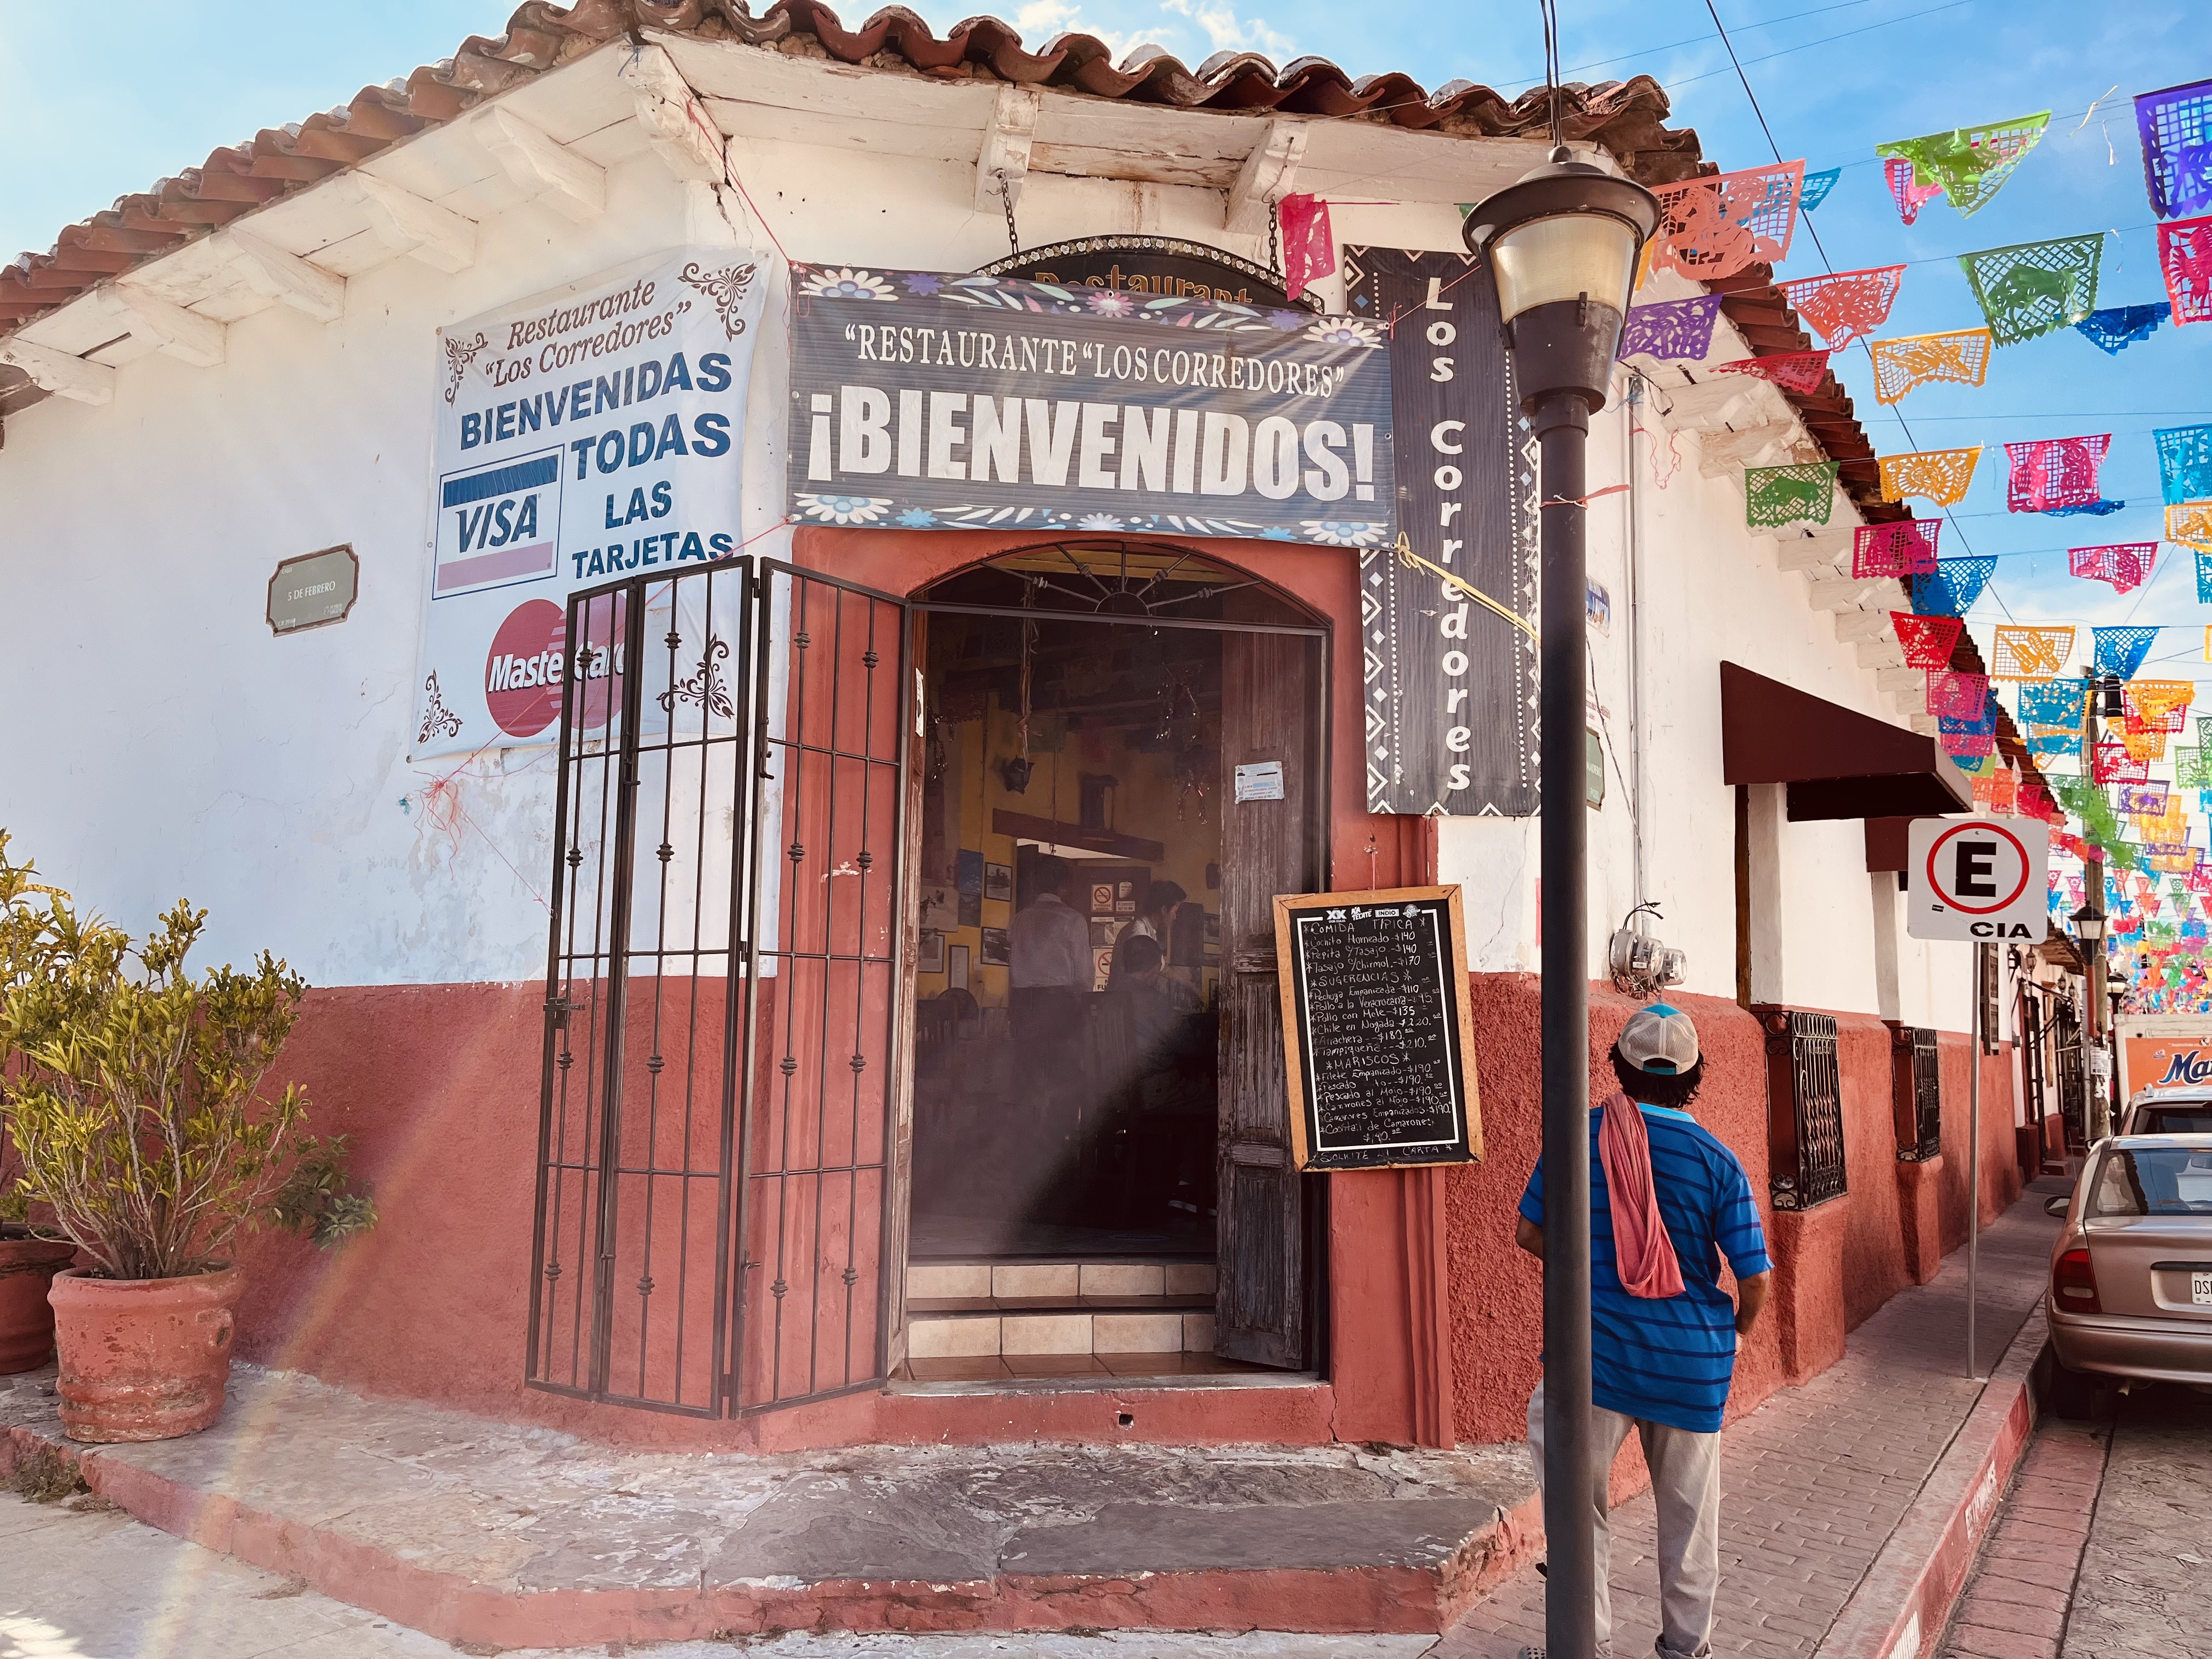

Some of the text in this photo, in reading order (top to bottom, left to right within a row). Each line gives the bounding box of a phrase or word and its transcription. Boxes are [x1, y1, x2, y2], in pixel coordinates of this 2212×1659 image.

[507, 280, 656, 350] Restaurante
[1425, 276, 1457, 383] Los
[461, 352, 732, 451] BIENVENIDAS
[571, 413, 731, 481] TODAS
[808, 385, 1375, 502] ¡BIENVENIDOS!
[455, 494, 538, 553] VISA
[605, 480, 672, 530] LAS
[572, 532, 734, 579] TARJETAS
[287, 580, 336, 602] 5 DE FEBRERO
[1430, 420, 1472, 791] Corredores
[487, 641, 627, 693] MasteCa
[1955, 841, 1997, 898] E
[1352, 910, 1372, 921] TECATE
[1970, 922, 2033, 939] CIA
[1334, 1053, 1400, 1070] MARISCOS
[2159, 1050, 2212, 1085] Ma
[1367, 1120, 1380, 1131] de
[1402, 1146, 1439, 1156] CARTA
